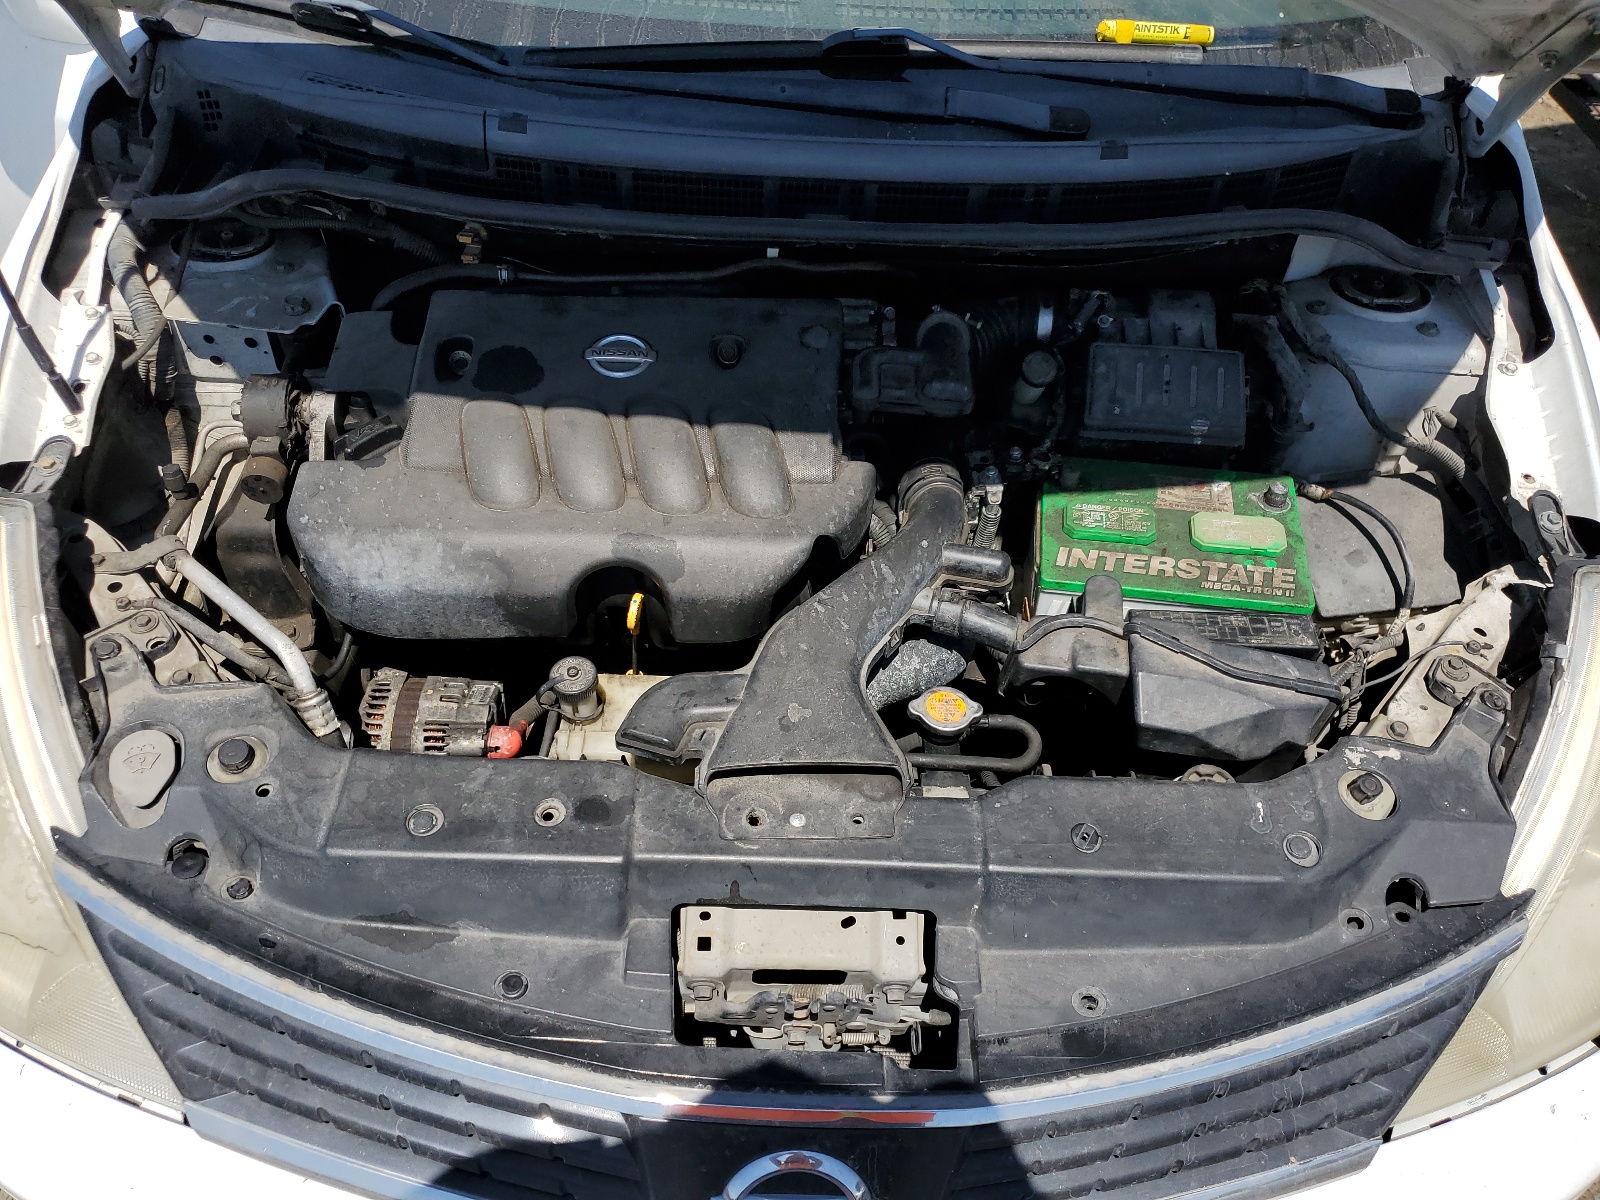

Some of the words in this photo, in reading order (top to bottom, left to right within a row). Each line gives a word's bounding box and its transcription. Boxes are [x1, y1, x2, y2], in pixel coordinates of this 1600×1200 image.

[1134, 23, 1181, 35] AINTSTIK
[591, 348, 649, 358] NISSAN
[1082, 503, 1111, 511] DANGER
[1056, 546, 1297, 590] INTERSTATE
